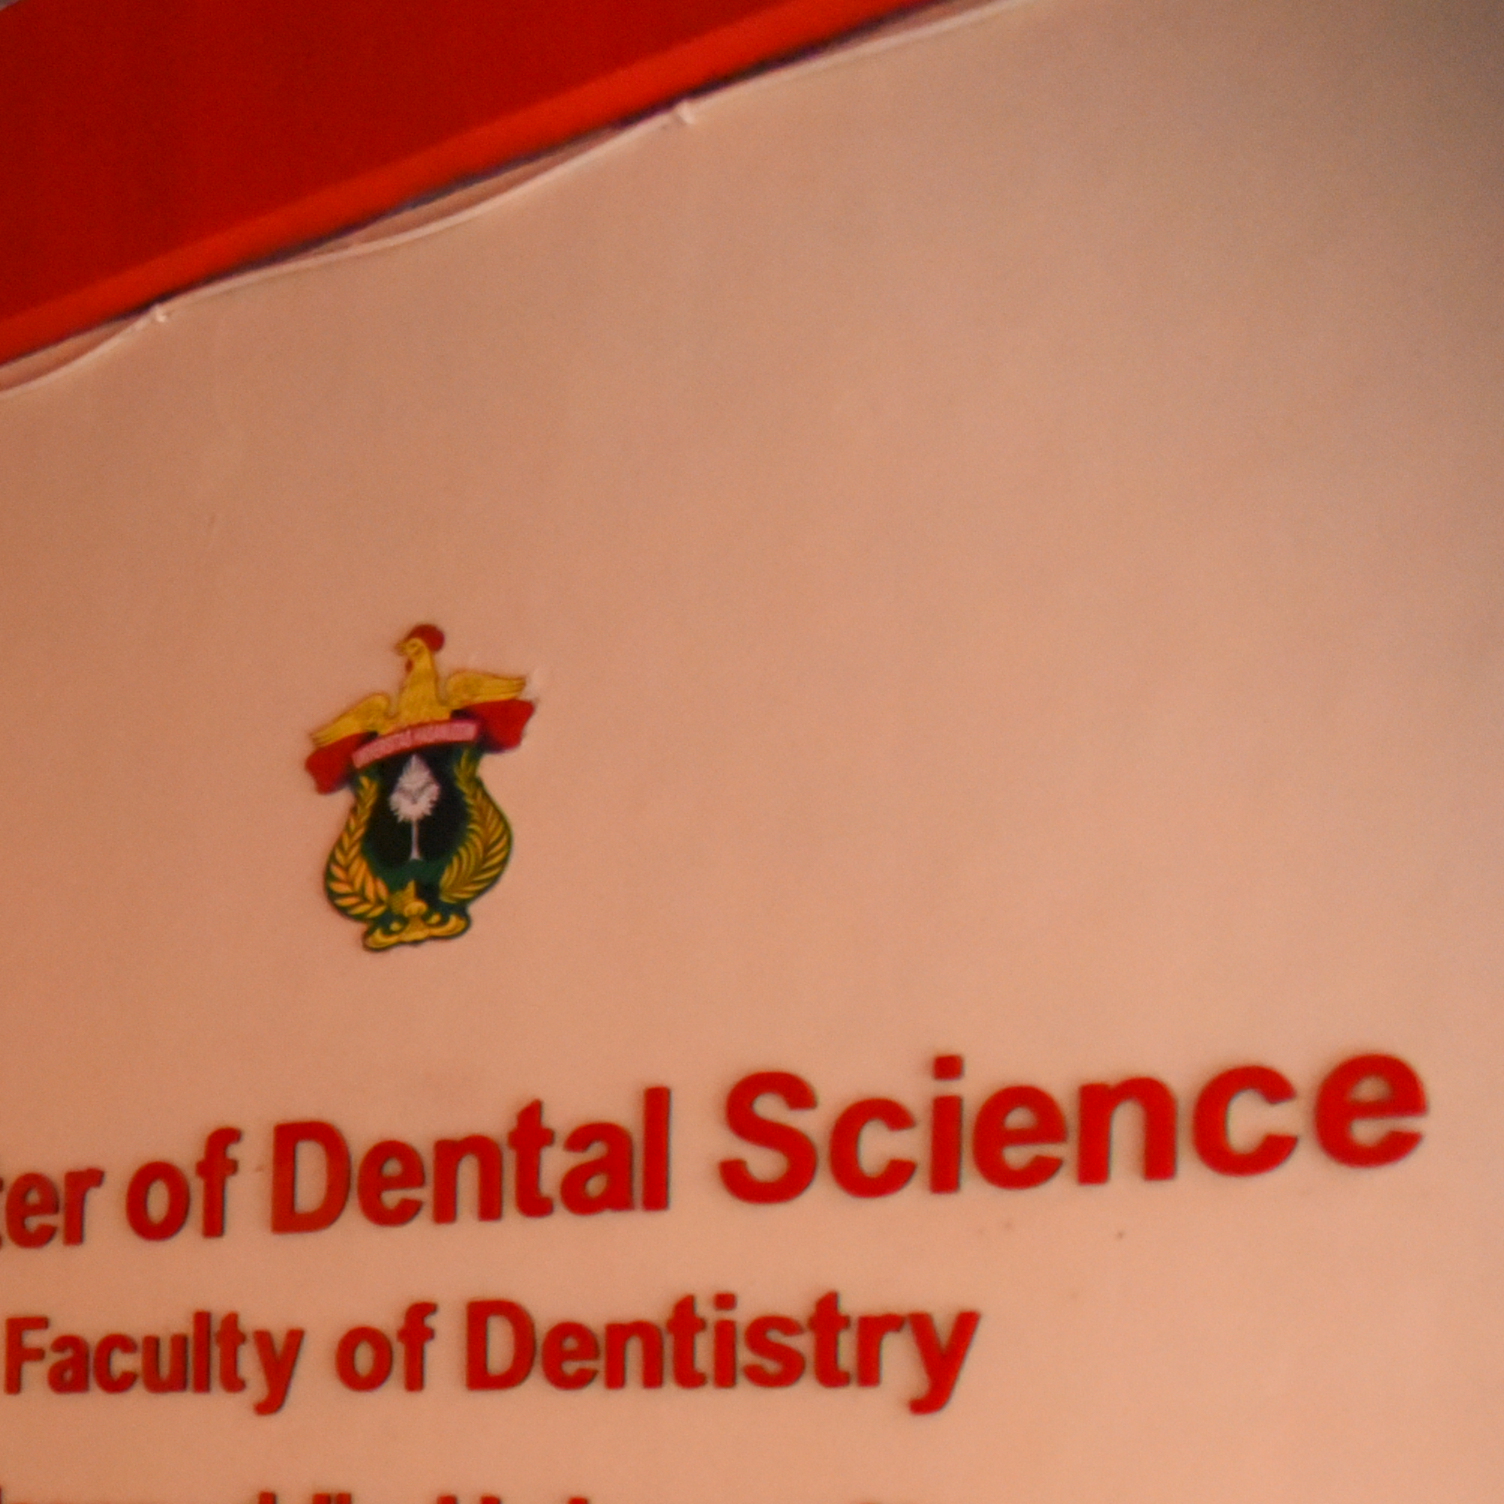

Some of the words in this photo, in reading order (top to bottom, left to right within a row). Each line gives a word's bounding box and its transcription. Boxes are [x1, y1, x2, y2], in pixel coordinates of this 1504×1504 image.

[125, 1126, 243, 1241] of
[270, 1087, 671, 1234] Dental
[717, 1053, 1429, 1204] Science
[3, 1311, 305, 1416] Faculty
[334, 1302, 438, 1392] of
[466, 1291, 980, 1415] Dentistry
